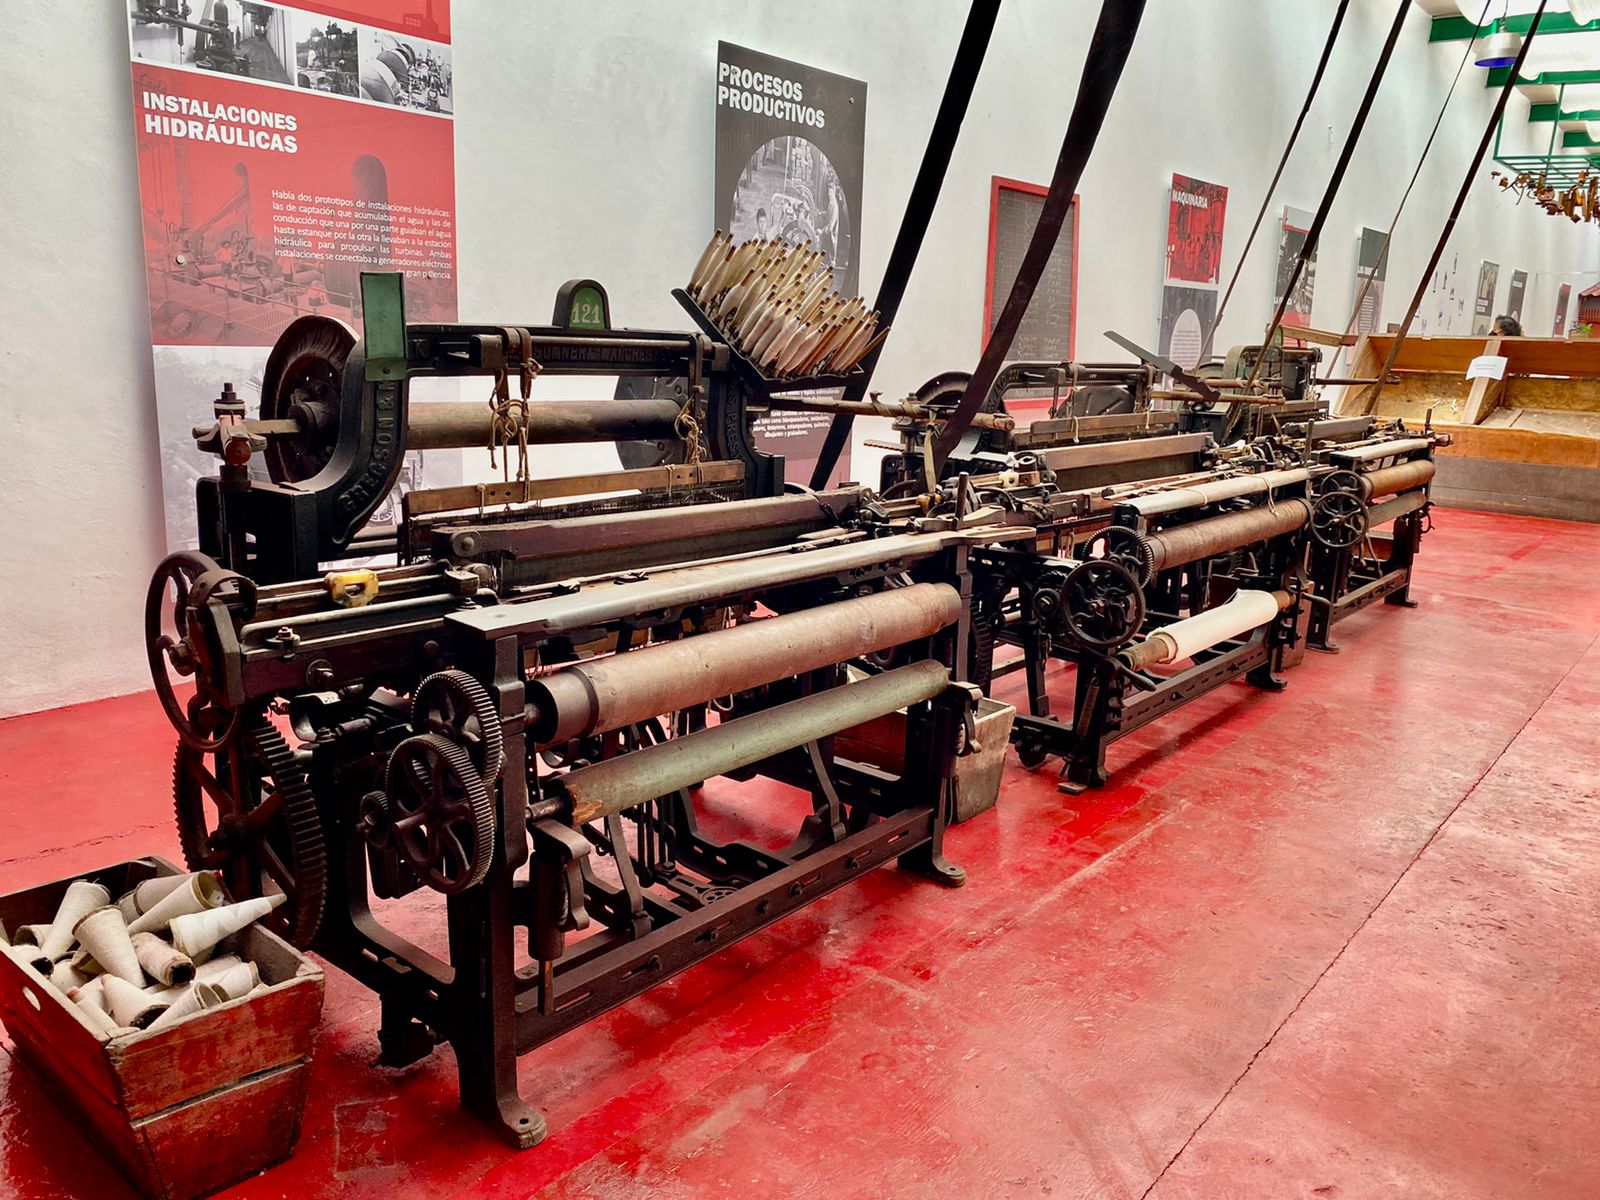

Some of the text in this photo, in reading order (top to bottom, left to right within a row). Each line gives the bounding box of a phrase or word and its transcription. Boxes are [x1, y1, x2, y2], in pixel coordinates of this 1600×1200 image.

[718, 62, 803, 102] PROCESOS
[143, 92, 297, 131] INSTALACIONES
[718, 85, 825, 128] PRODUCTIVOS
[145, 114, 298, 154] HIDRÁULICAS
[272, 190, 295, 200] Había
[298, 193, 312, 202] dos
[315, 195, 353, 207] prototipos
[356, 200, 366, 208] de
[368, 201, 412, 213] instalaciones
[272, 201, 284, 211] las
[286, 203, 296, 212] de
[299, 205, 335, 216] captación
[338, 210, 352, 218] que
[354, 211, 397, 222] acumulaban
[407, 217, 424, 226] agua
[432, 219, 441, 227] las
[273, 214, 318, 226] conducción
[319, 219, 334, 228] que
[381, 225, 399, 233] parte
[400, 227, 426, 236] guiaban
[428, 229, 434, 237] el
[435, 231, 451, 239] agua
[273, 224, 295, 234] hasta
[297, 229, 333, 239] estanque
[334, 232, 347, 240] por
[349, 231, 355, 239] la
[357, 234, 372, 242] otra
[373, 234, 380, 242] la
[381, 235, 410, 245] llevaban
[417, 238, 423, 246] la
[424, 239, 452, 248] estación
[274, 236, 452, 259] hidráulica para propulsar las turbinas. Ambas
[275, 248, 325, 260] instalaciones
[335, 253, 372, 263] conectaba
[378, 257, 421, 267] generadores
[422, 260, 452, 270] eléctricos
[571, 303, 601, 324] 121
